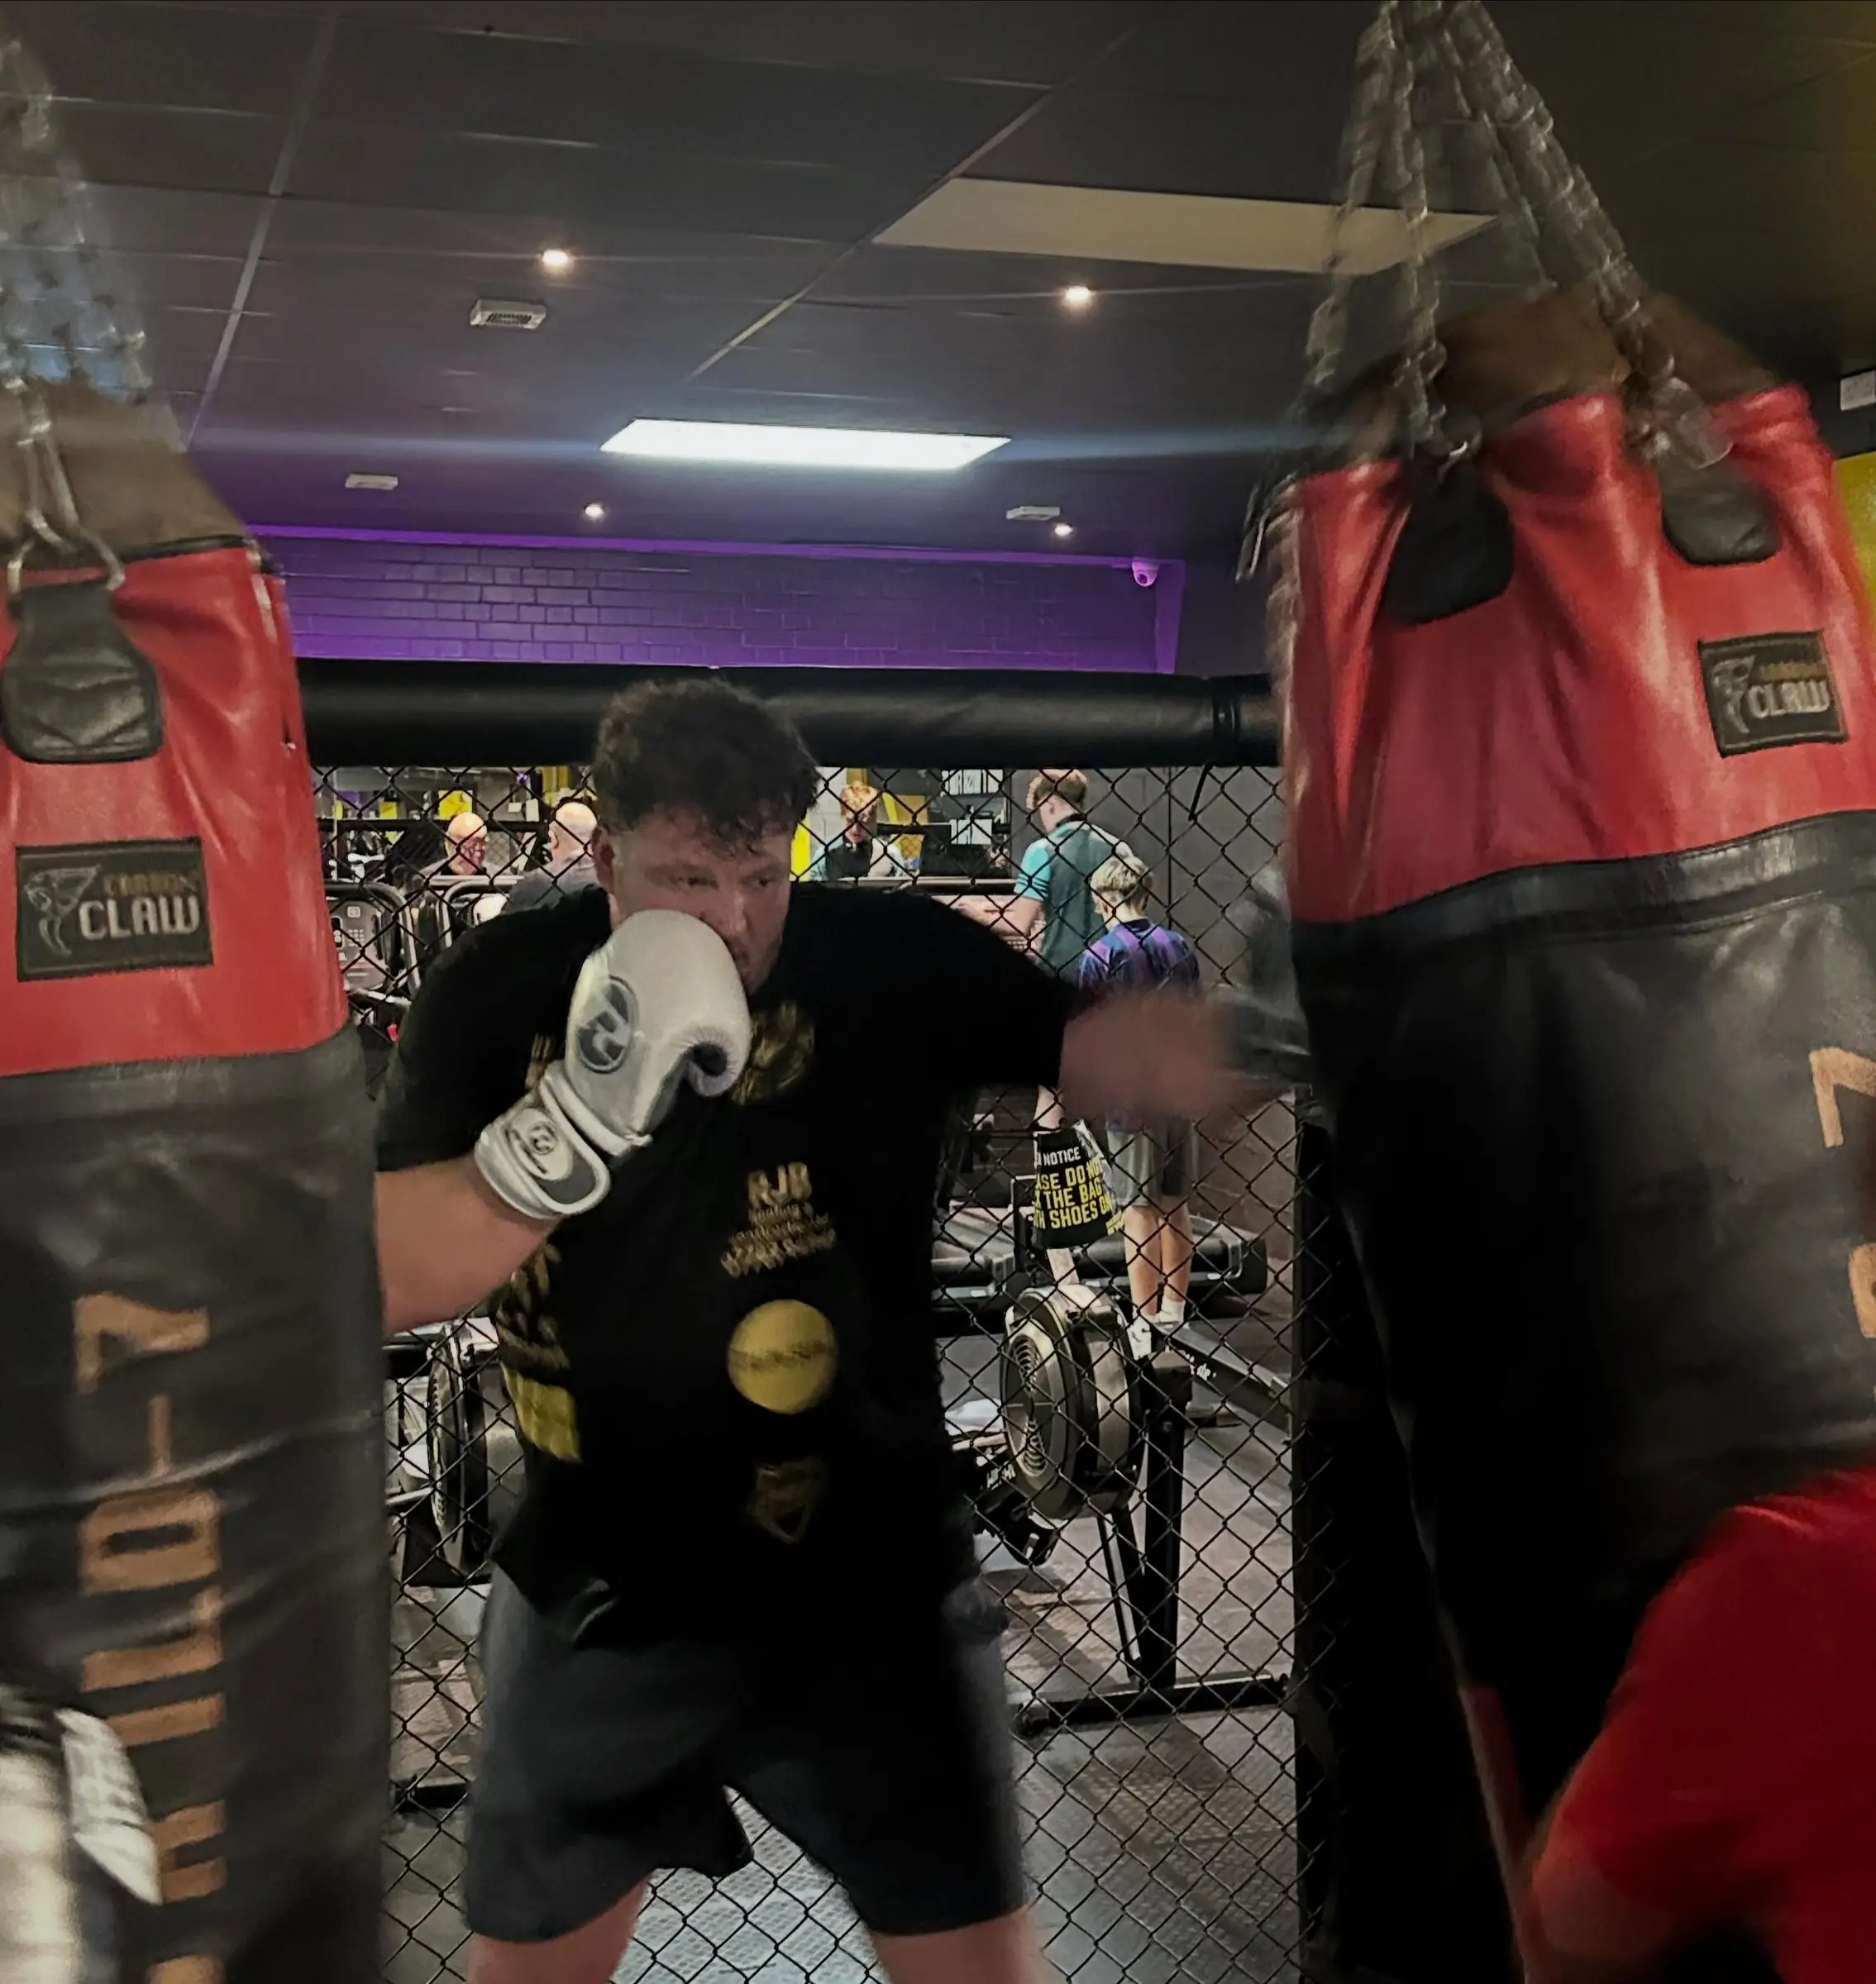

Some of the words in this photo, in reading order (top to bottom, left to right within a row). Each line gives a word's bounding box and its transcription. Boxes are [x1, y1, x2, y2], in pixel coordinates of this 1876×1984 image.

[79, 894, 200, 940] CLAW
[1043, 1147, 1081, 1166] NOTICE
[1065, 1165, 1086, 1187] DO
[1043, 1188, 1075, 1209] THE
[1079, 1177, 1103, 1203] BAG
[1049, 1201, 1099, 1229] SHOES
